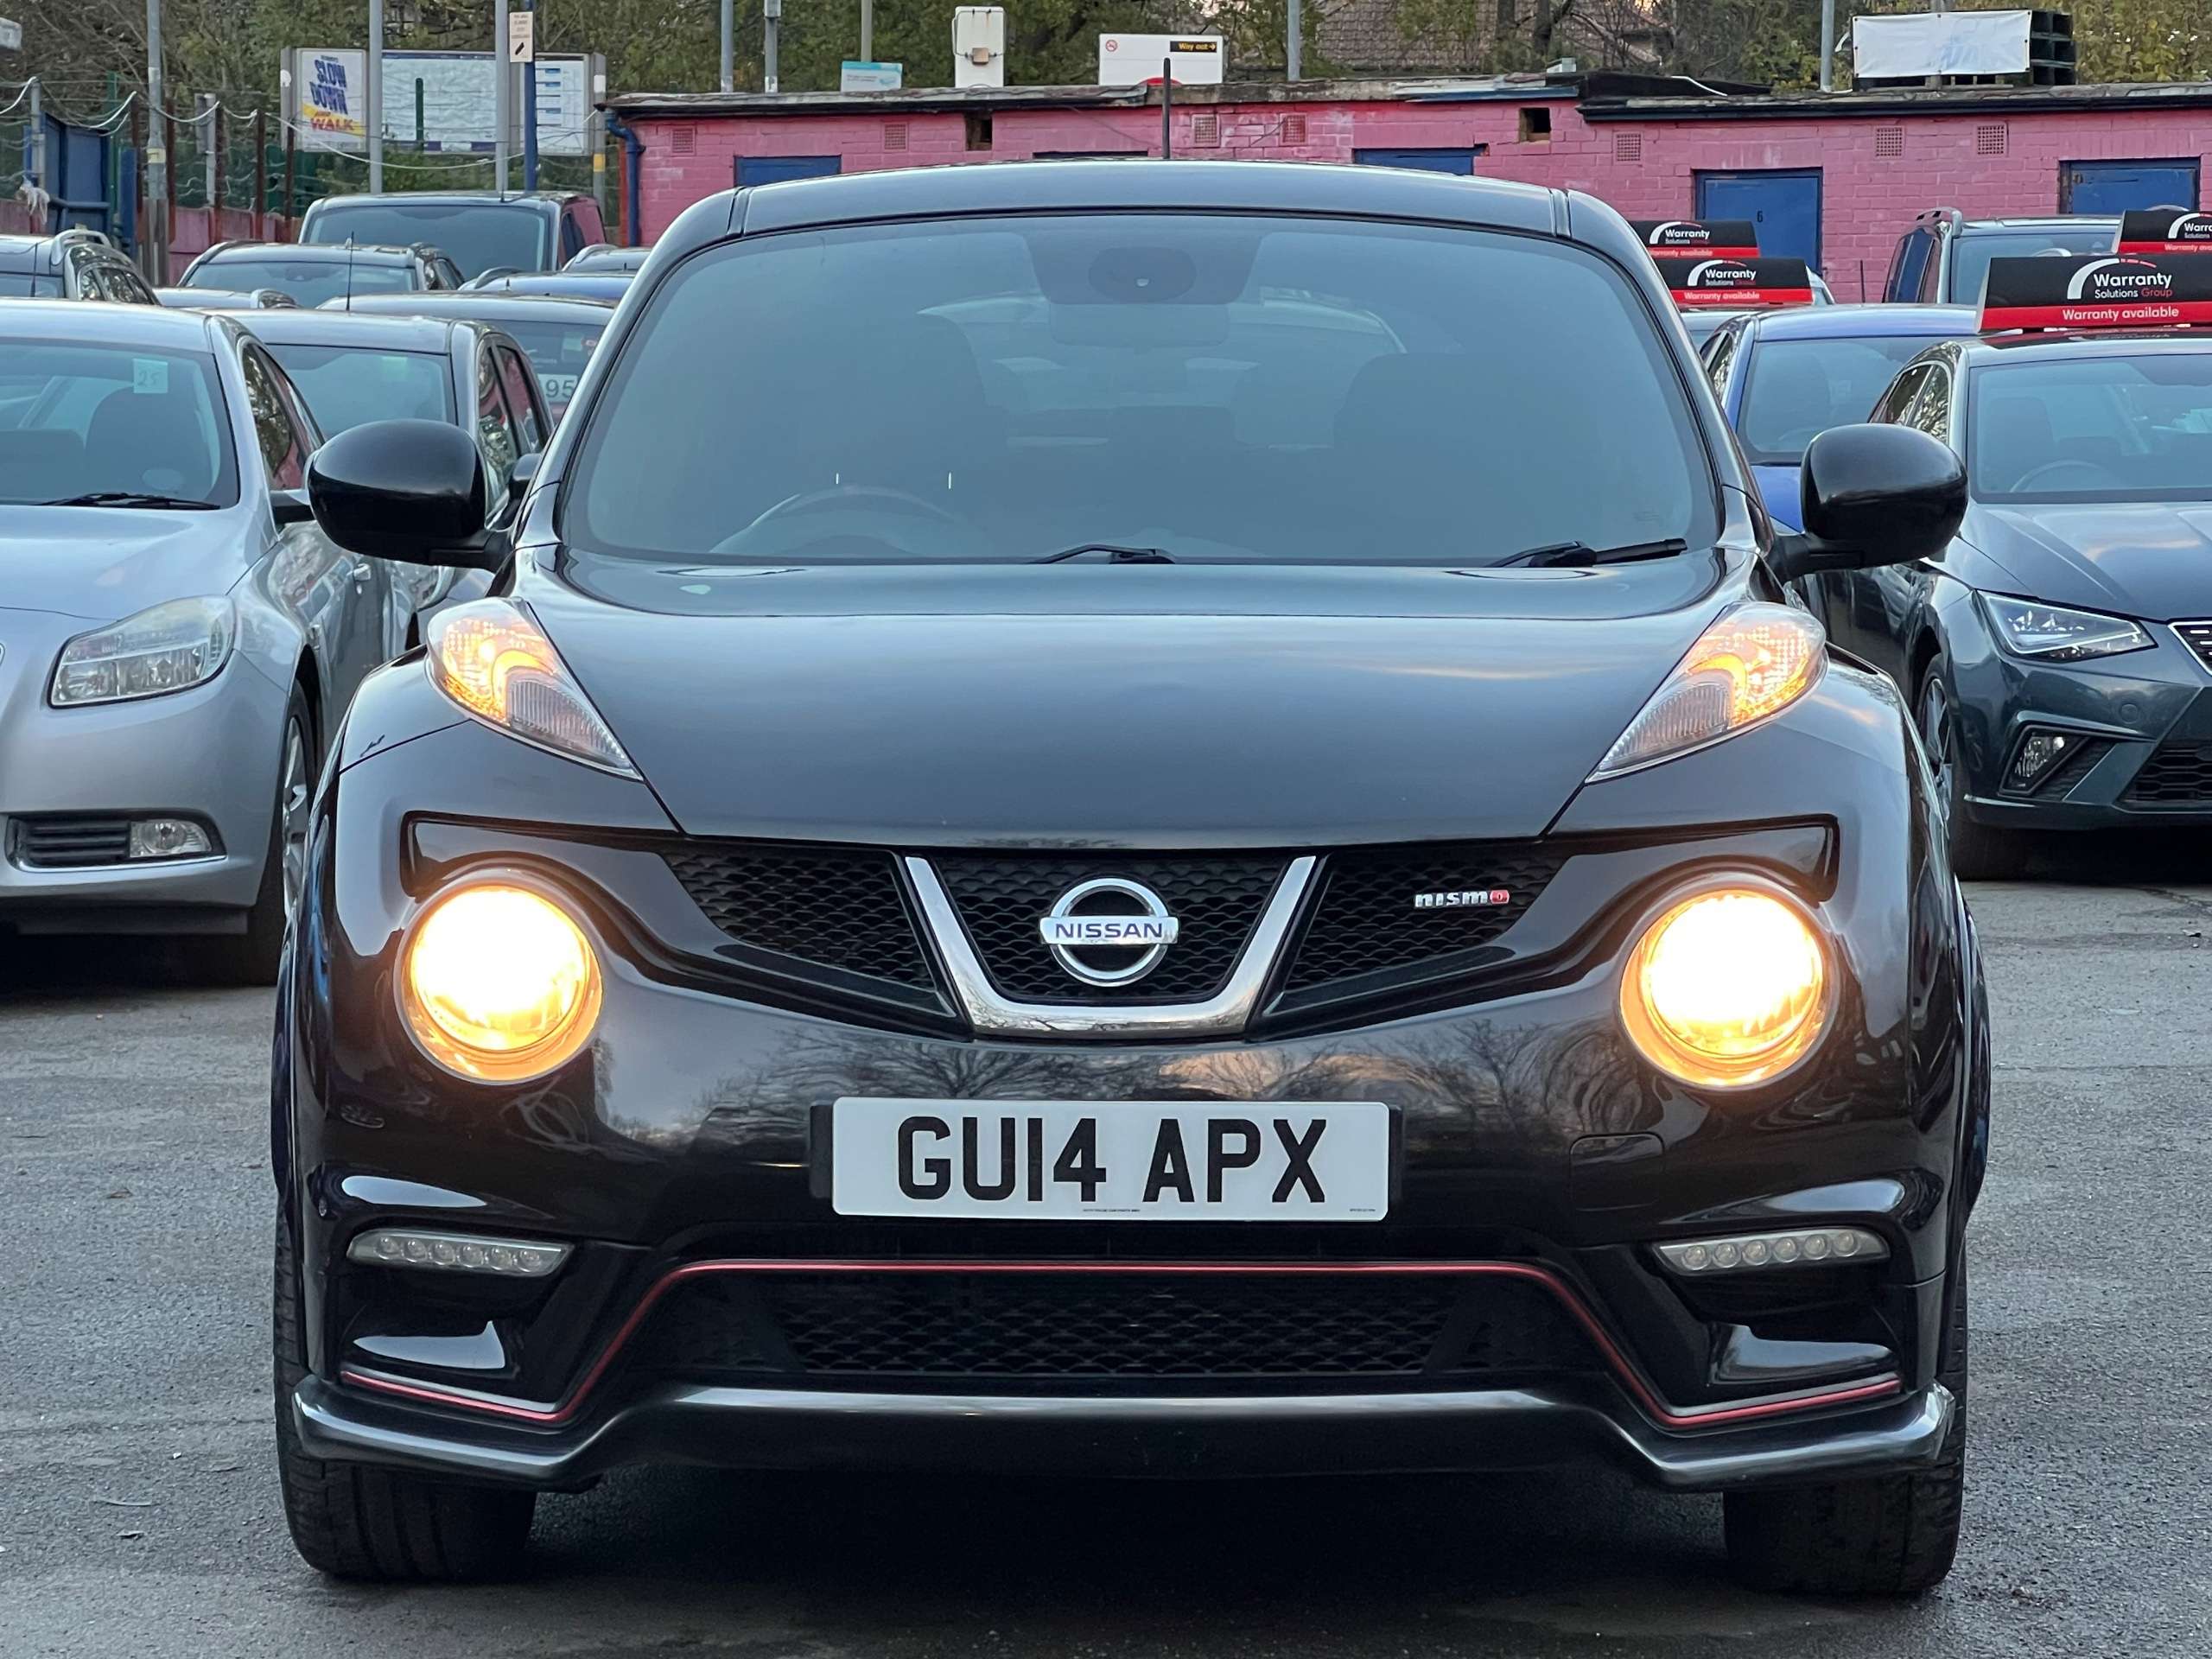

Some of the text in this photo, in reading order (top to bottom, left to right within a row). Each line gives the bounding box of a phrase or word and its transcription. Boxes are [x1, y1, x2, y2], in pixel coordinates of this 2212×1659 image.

[1178, 42, 1193, 51] Way
[311, 118, 353, 130] WALK
[1757, 210, 1764, 223] 6
[1664, 229, 1711, 240] Warranty
[2164, 243, 2199, 252] Warranty
[1705, 269, 1757, 281] Warranty
[2093, 272, 2172, 289] Warranty
[1683, 291, 1760, 302] Warranty available
[2094, 288, 2173, 299] Solutions Group
[2062, 305, 2179, 322] Warranty available
[137, 371, 162, 387] 25
[1415, 889, 1510, 907] nismo
[1055, 923, 1163, 939] NISSAN
[897, 1116, 1326, 1204] GU14 APX
